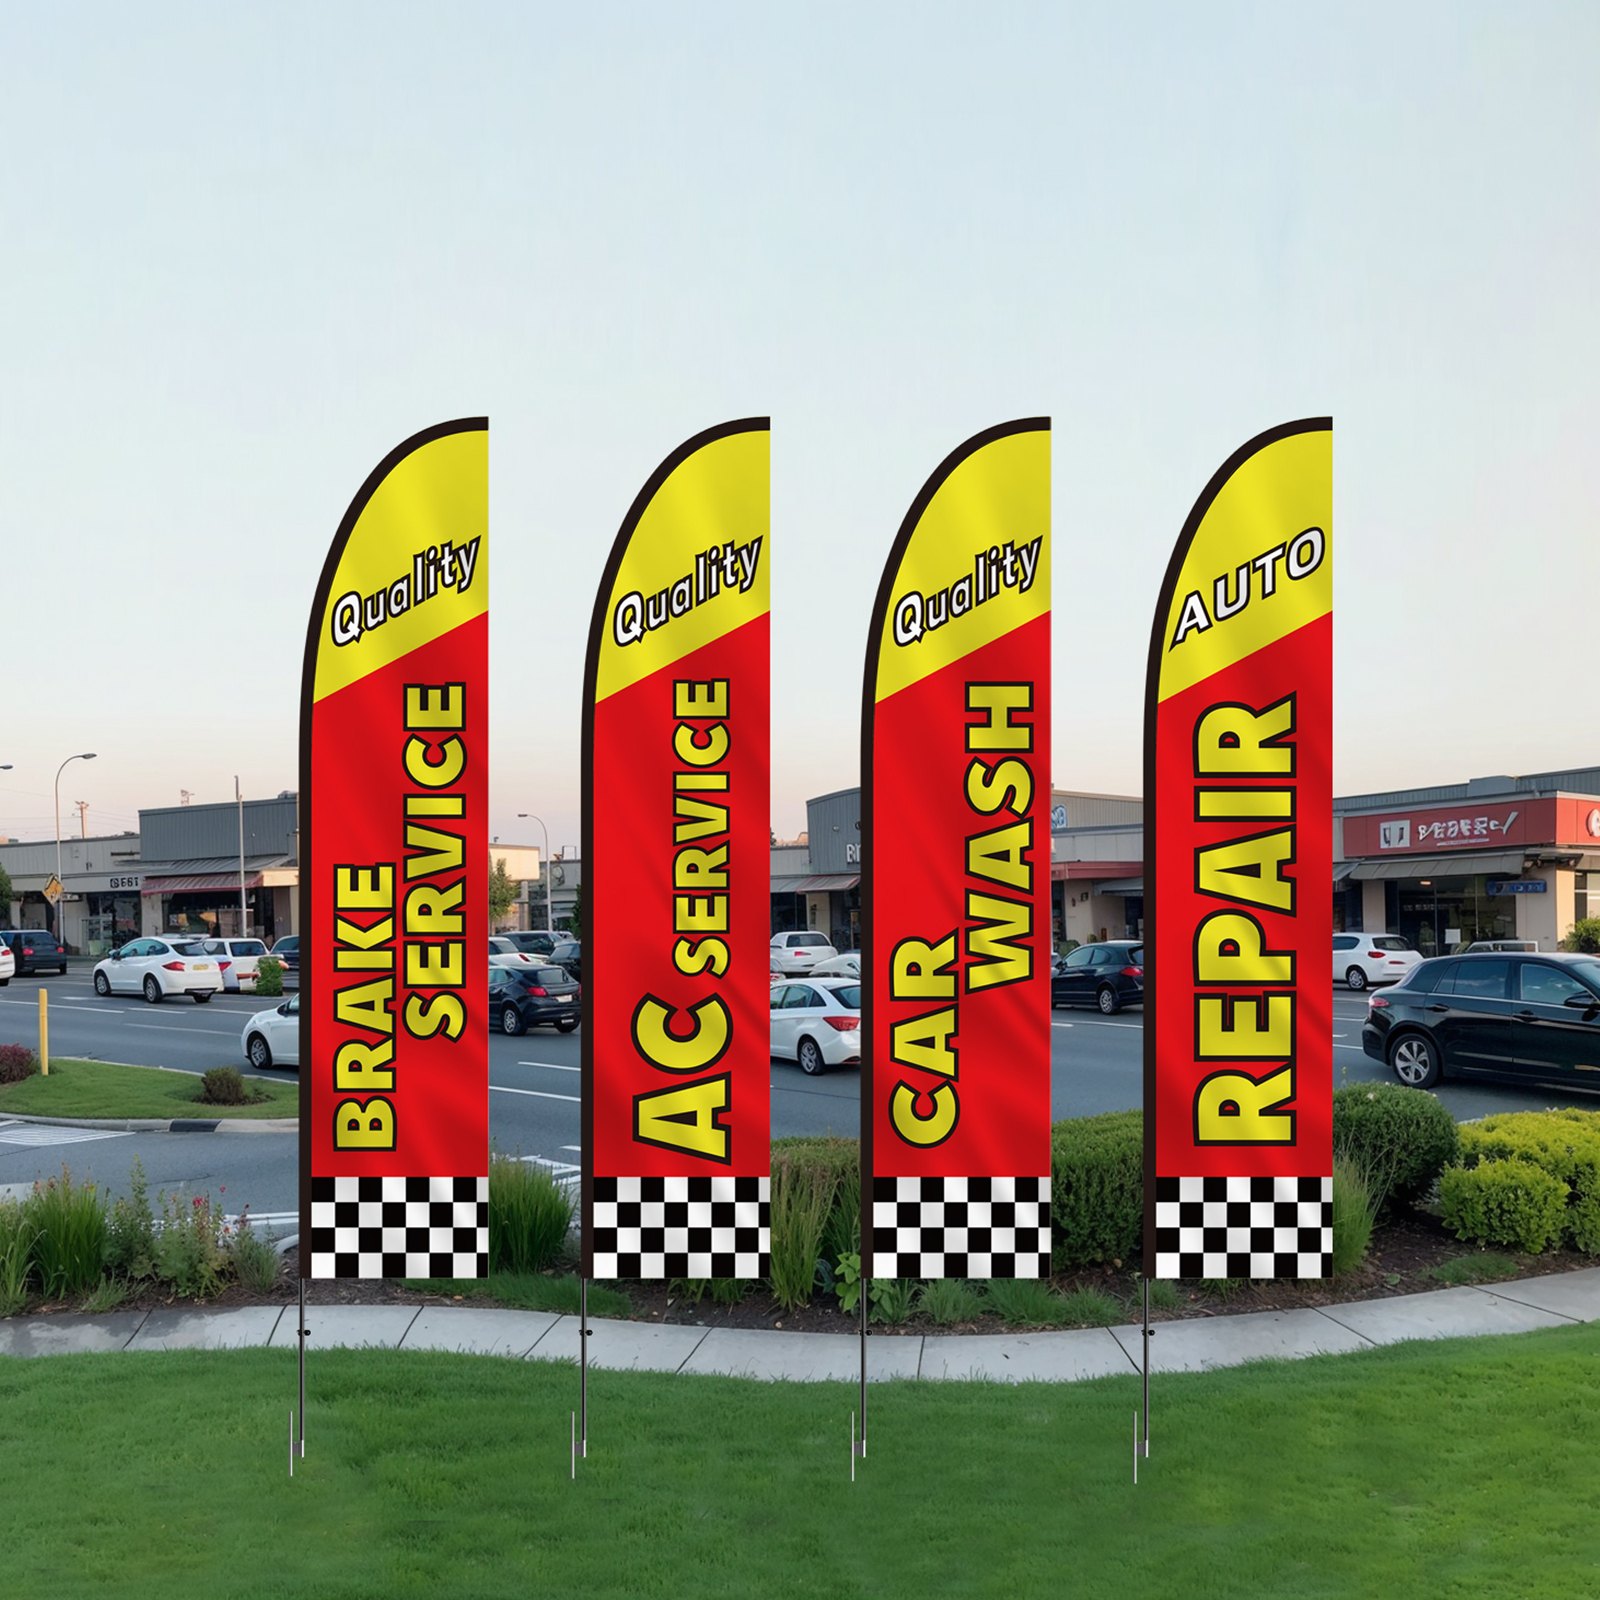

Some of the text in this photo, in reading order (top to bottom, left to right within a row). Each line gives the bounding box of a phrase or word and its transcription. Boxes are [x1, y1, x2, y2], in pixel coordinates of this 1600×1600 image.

[331, 535, 481, 647] Quality
[613, 535, 763, 647] Quality
[893, 535, 1043, 647] Quality
[1169, 527, 1325, 652] AUTO
[403, 681, 467, 1043] SERVICE
[631, 677, 733, 1165] AC SERVICE
[964, 681, 1035, 994] WASH
[1193, 690, 1296, 1146] REPAIR
[333, 862, 396, 1152] BRAKE
[888, 928, 960, 1148] CAR
